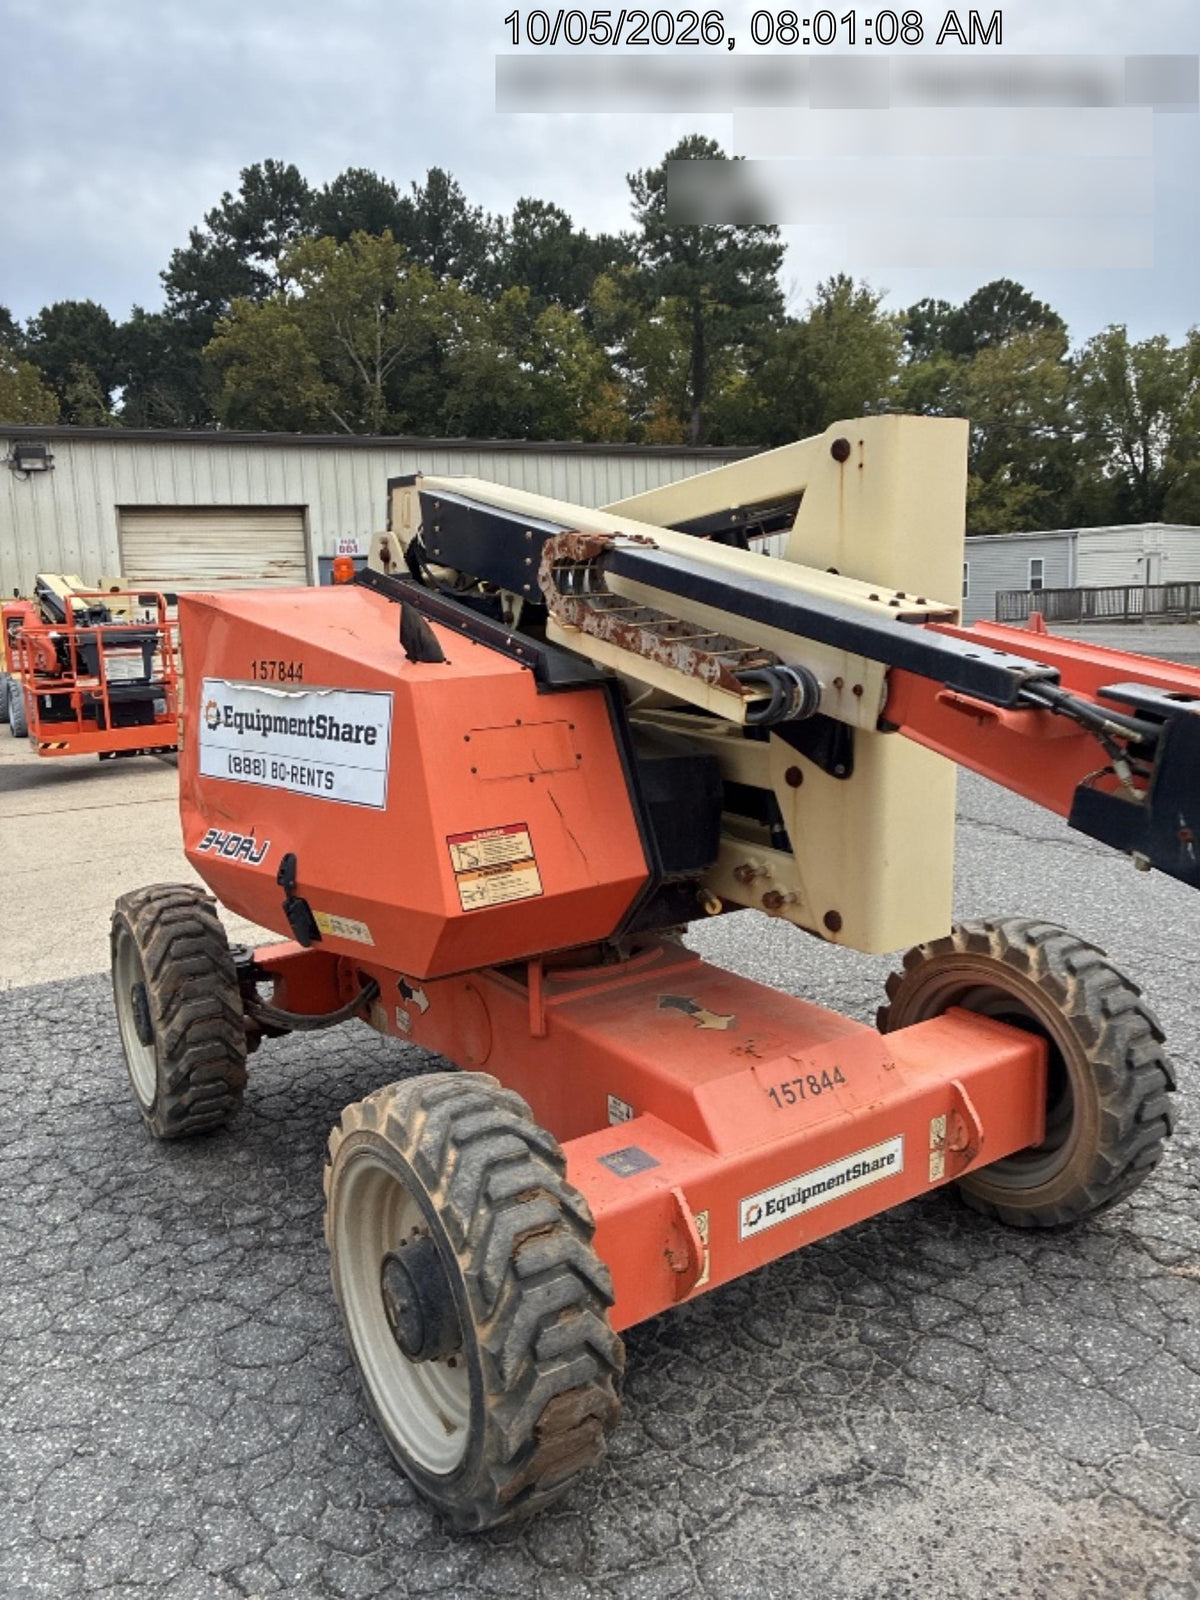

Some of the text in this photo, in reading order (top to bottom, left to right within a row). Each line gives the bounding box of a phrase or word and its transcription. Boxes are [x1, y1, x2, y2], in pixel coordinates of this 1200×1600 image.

[251, 660, 304, 682] 157844
[223, 705, 378, 746] EquipmentShare
[228, 753, 267, 779] (888)
[197, 829, 271, 866] 340AJ
[768, 1065, 846, 1109] 157844
[764, 1152, 896, 1217] EquipmentShare
